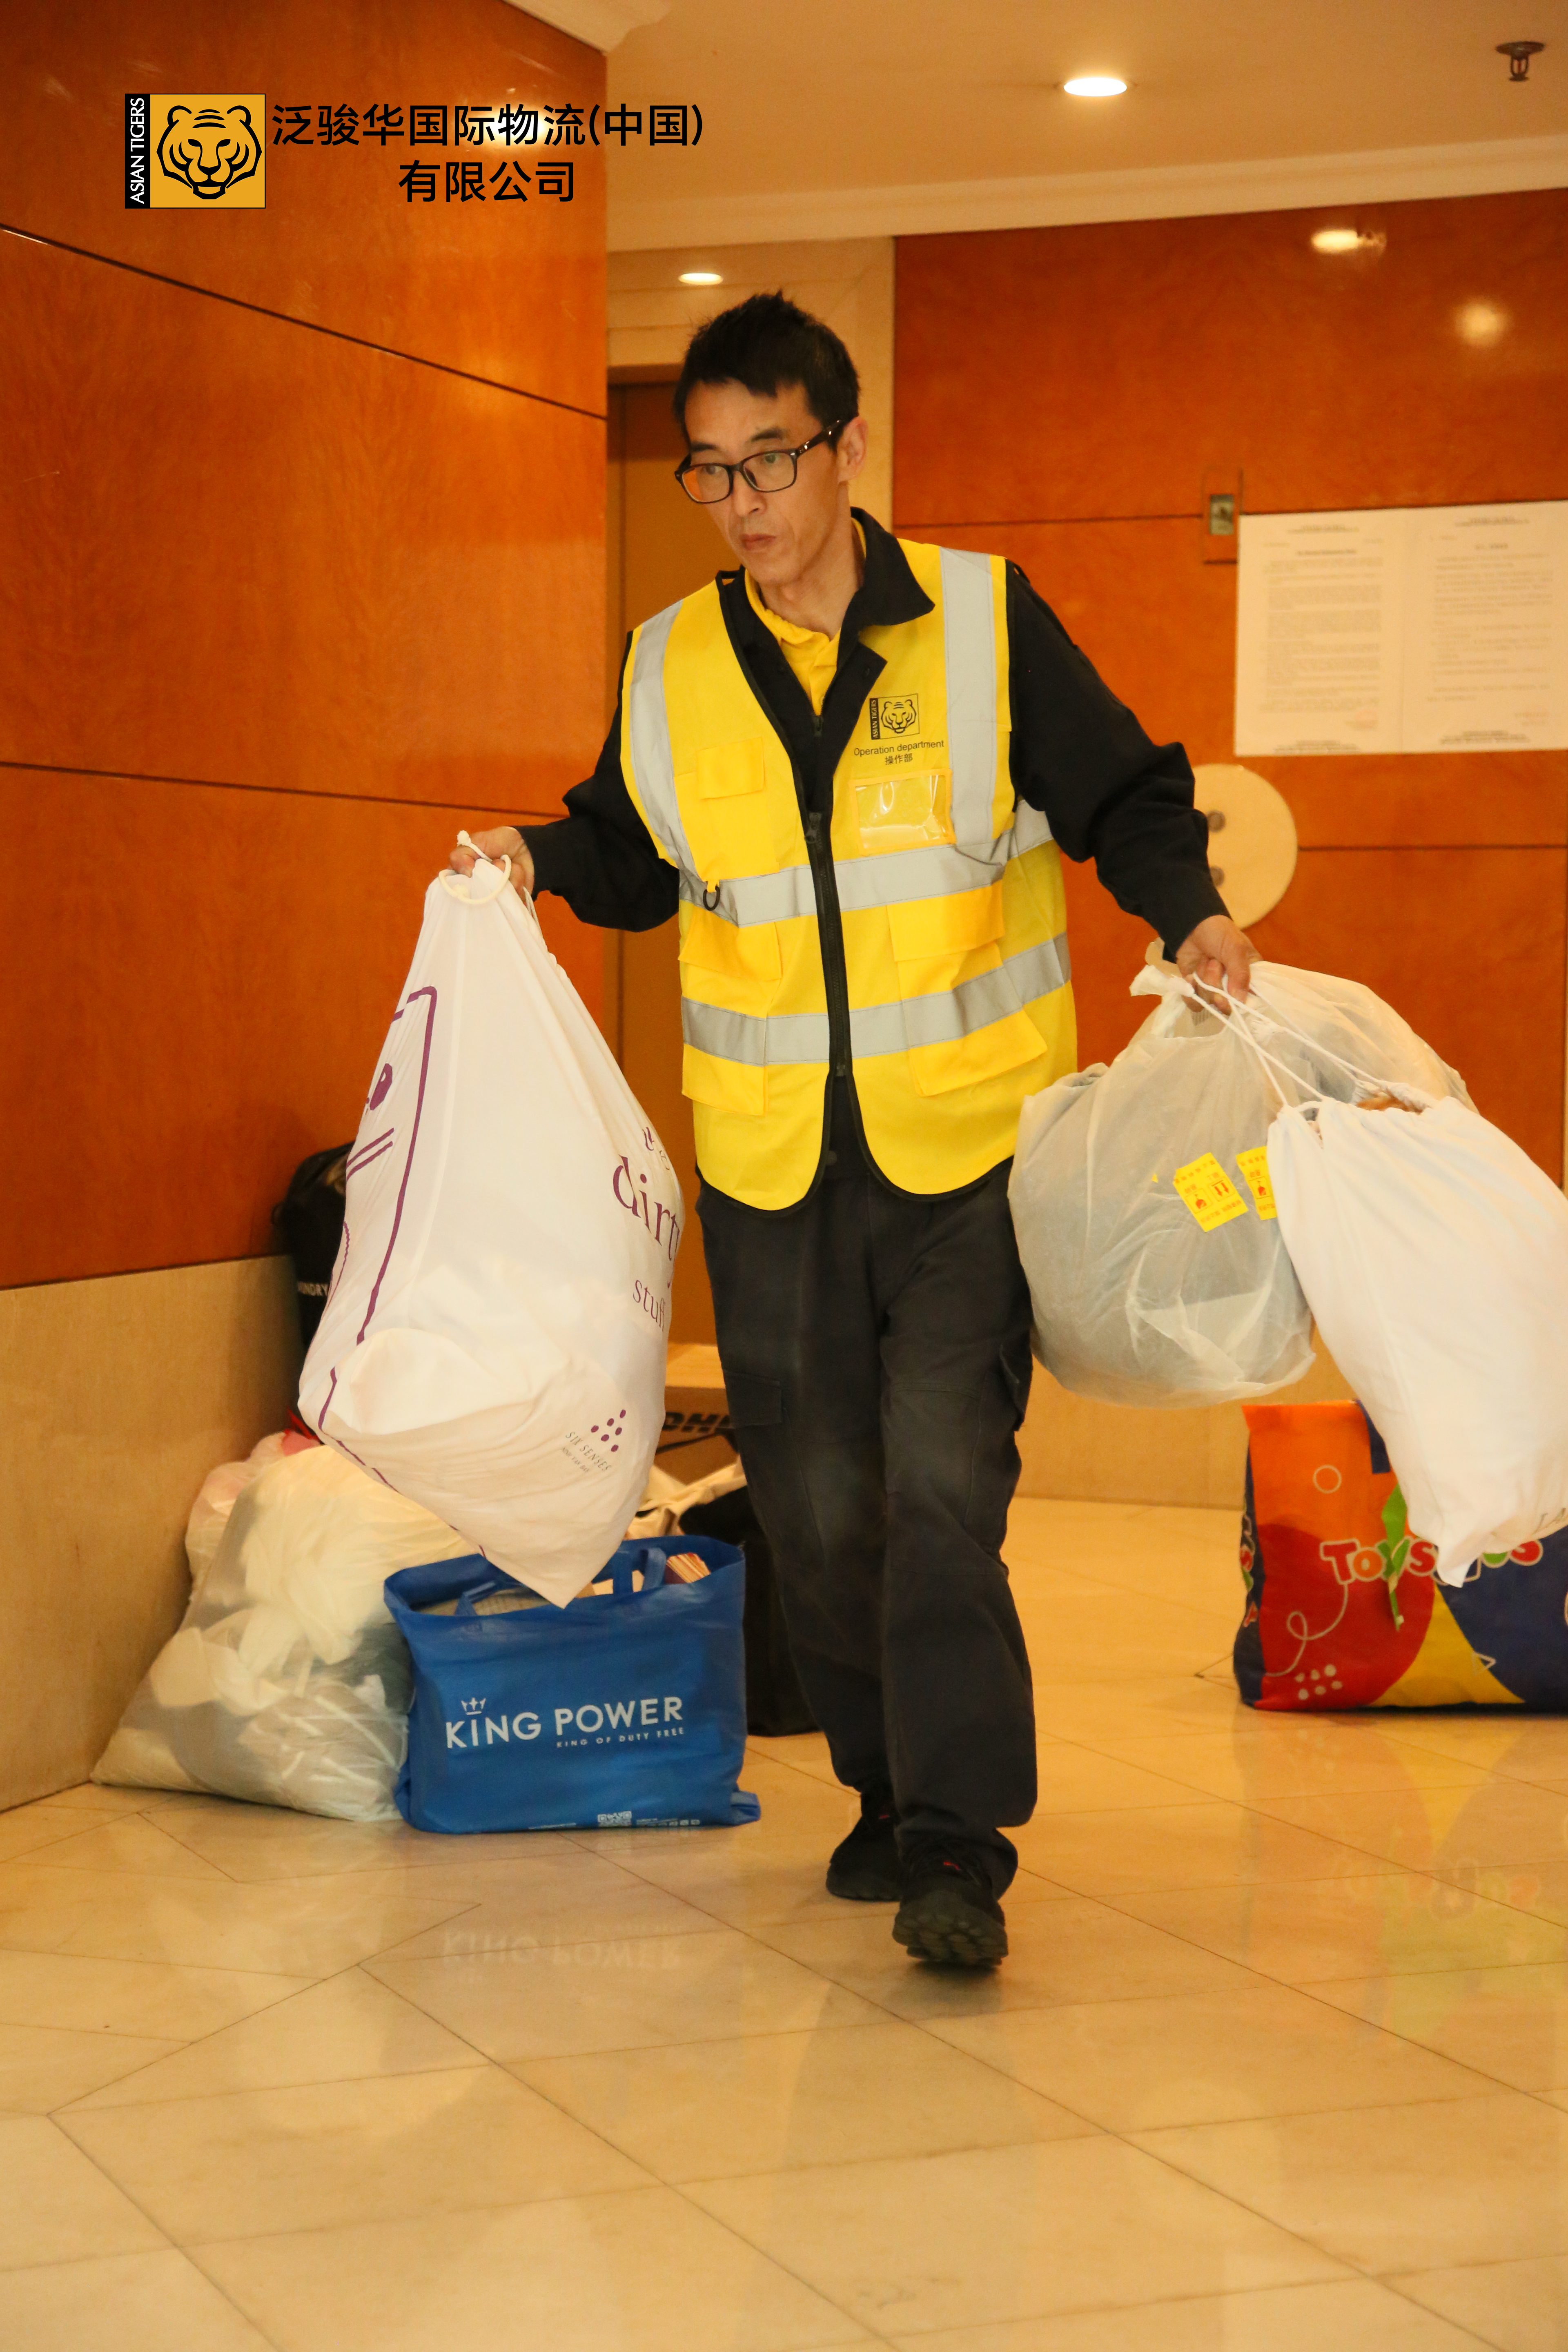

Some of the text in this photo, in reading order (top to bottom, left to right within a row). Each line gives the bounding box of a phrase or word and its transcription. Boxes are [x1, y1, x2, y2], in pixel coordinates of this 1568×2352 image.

[854, 740, 944, 757] Operation department
[885, 753, 913, 765] 操作部
[566, 1432, 583, 1446] SIX
[579, 1445, 611, 1471] SENSES
[446, 1696, 682, 1748] KING POWER
[557, 1727, 684, 1748] KING OF DUTY FREE
